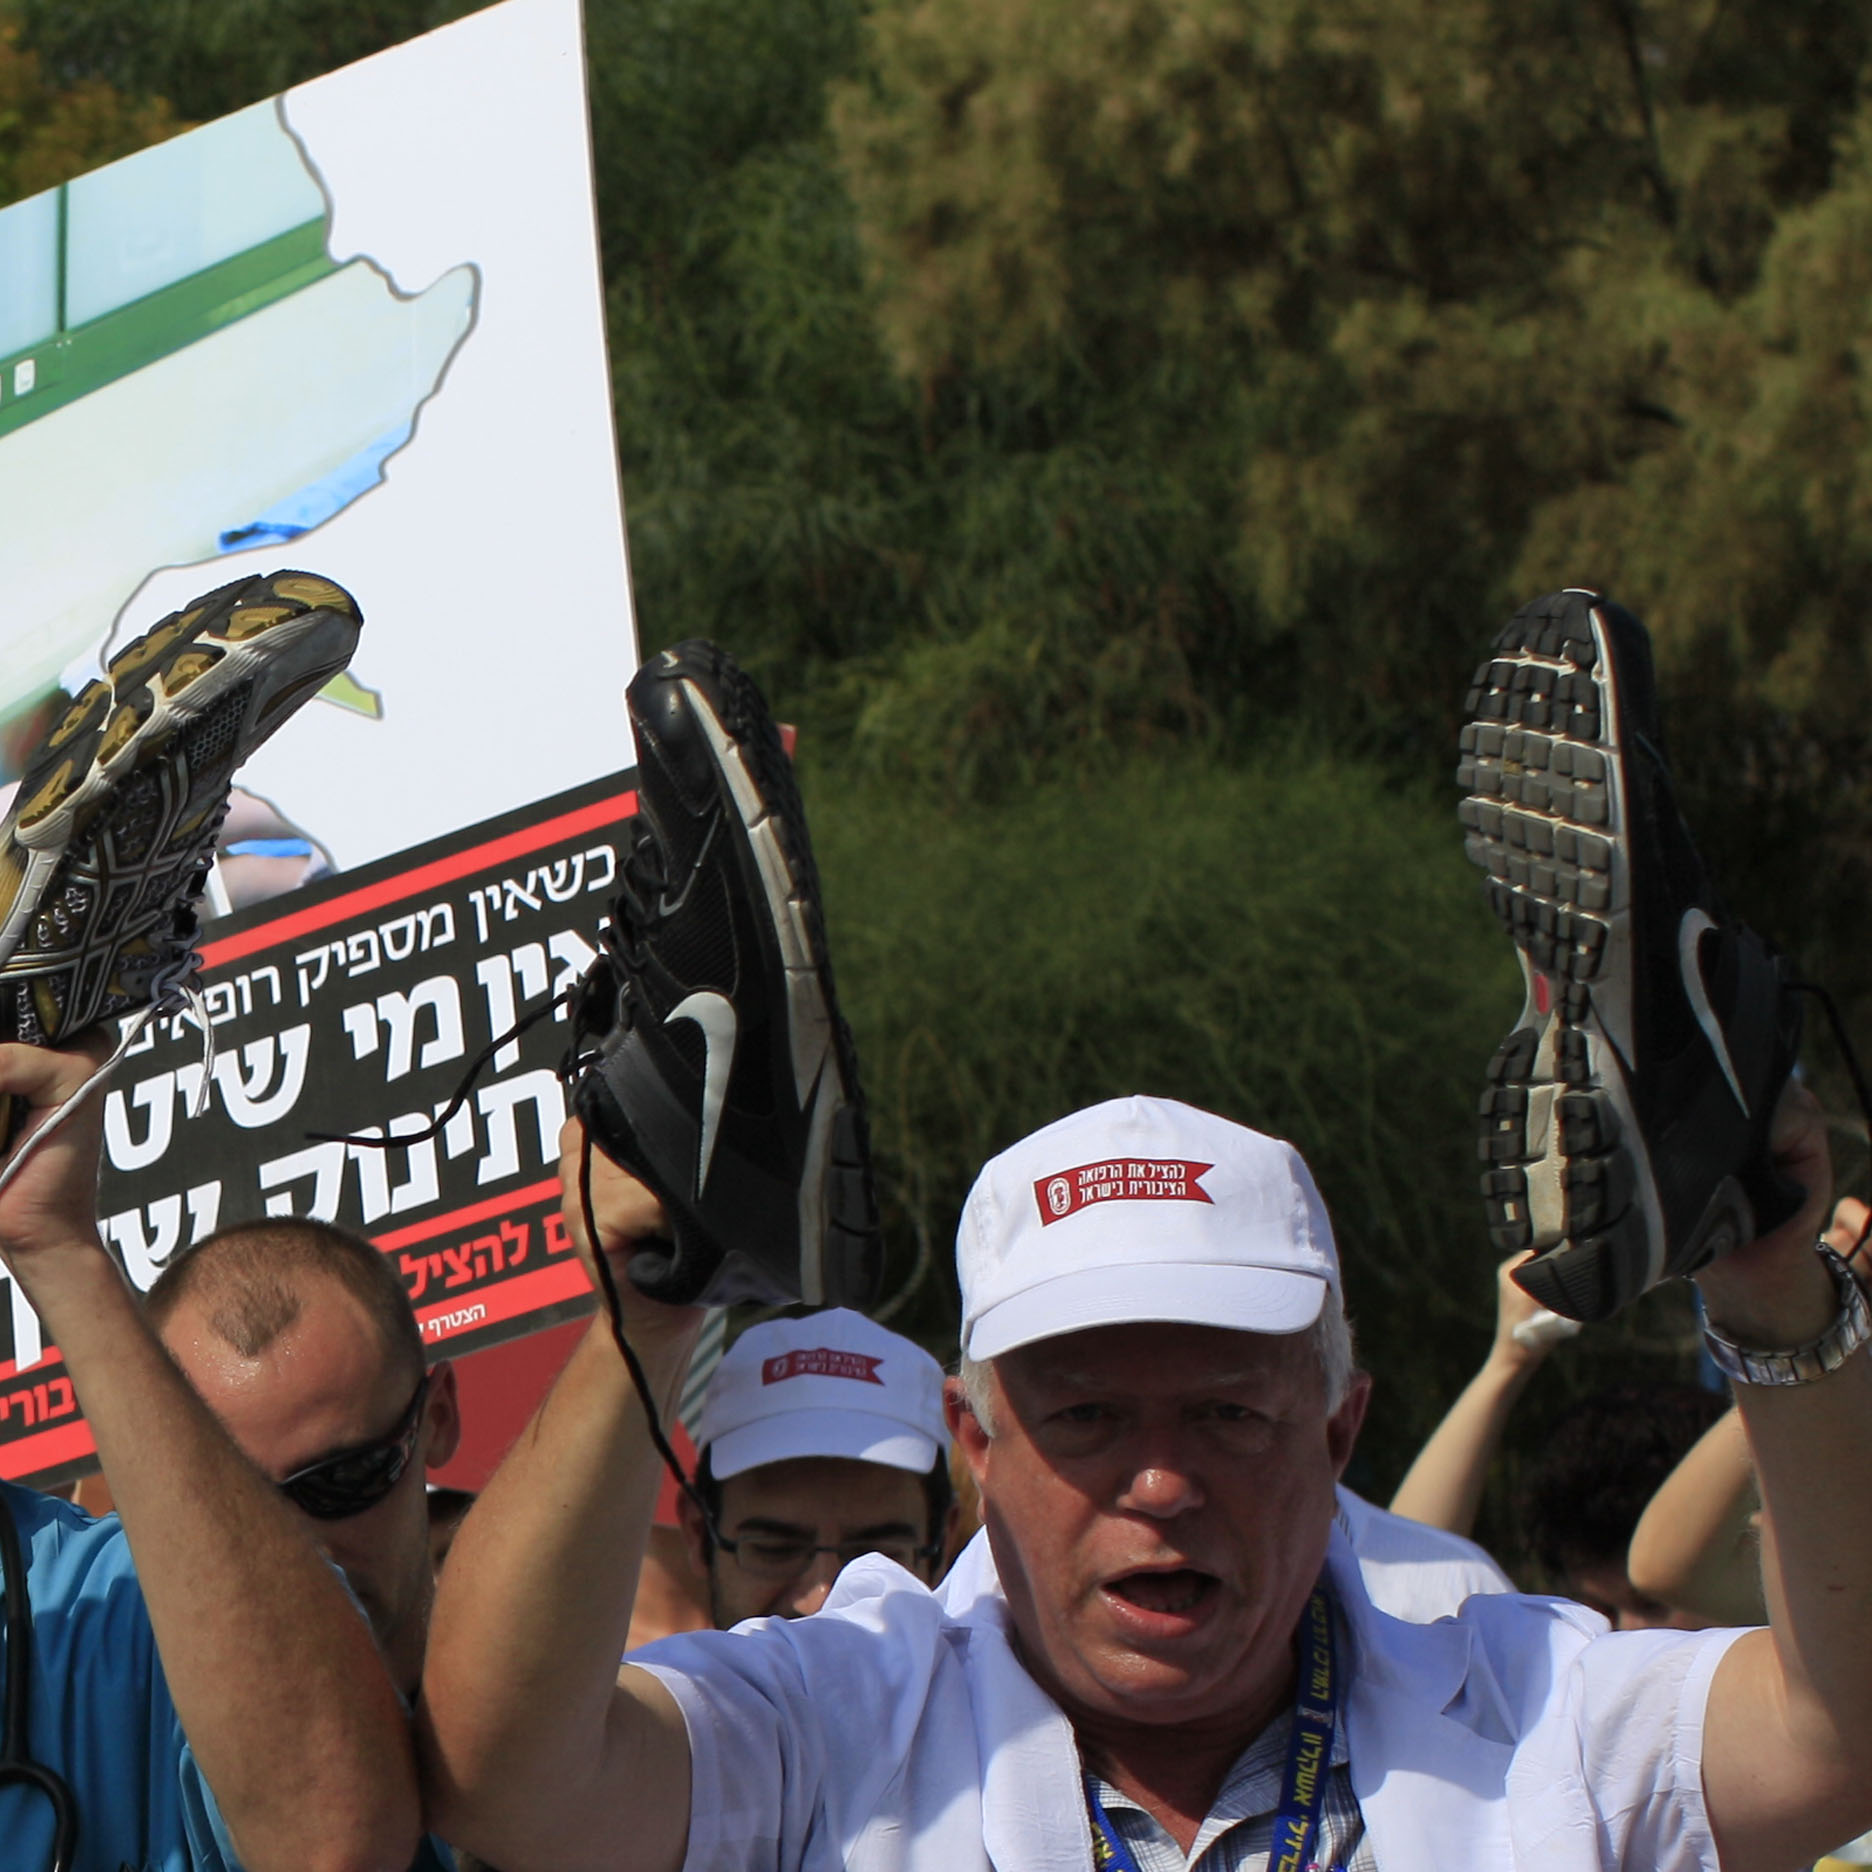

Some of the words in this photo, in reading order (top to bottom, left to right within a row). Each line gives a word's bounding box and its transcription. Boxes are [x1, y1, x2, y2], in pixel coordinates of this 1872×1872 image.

[468, 843, 617, 943] כשאין
[295, 902, 455, 1007] מספיק
[342, 974, 466, 1083] מי
[475, 917, 613, 1074] אין
[103, 1023, 312, 1172] שיט
[258, 1066, 572, 1226] תינוק
[1078, 1163, 1124, 1187] הרפואה
[1127, 1163, 1147, 1180] את
[1148, 1162, 1187, 1180] להציל
[1078, 1181, 1124, 1205] בישראל
[1128, 1180, 1187, 1197] הציבורית
[400, 1216, 530, 1300] להציל
[428, 1303, 487, 1340] הצטרף
[1293, 1732, 1324, 1807] אשקלון
